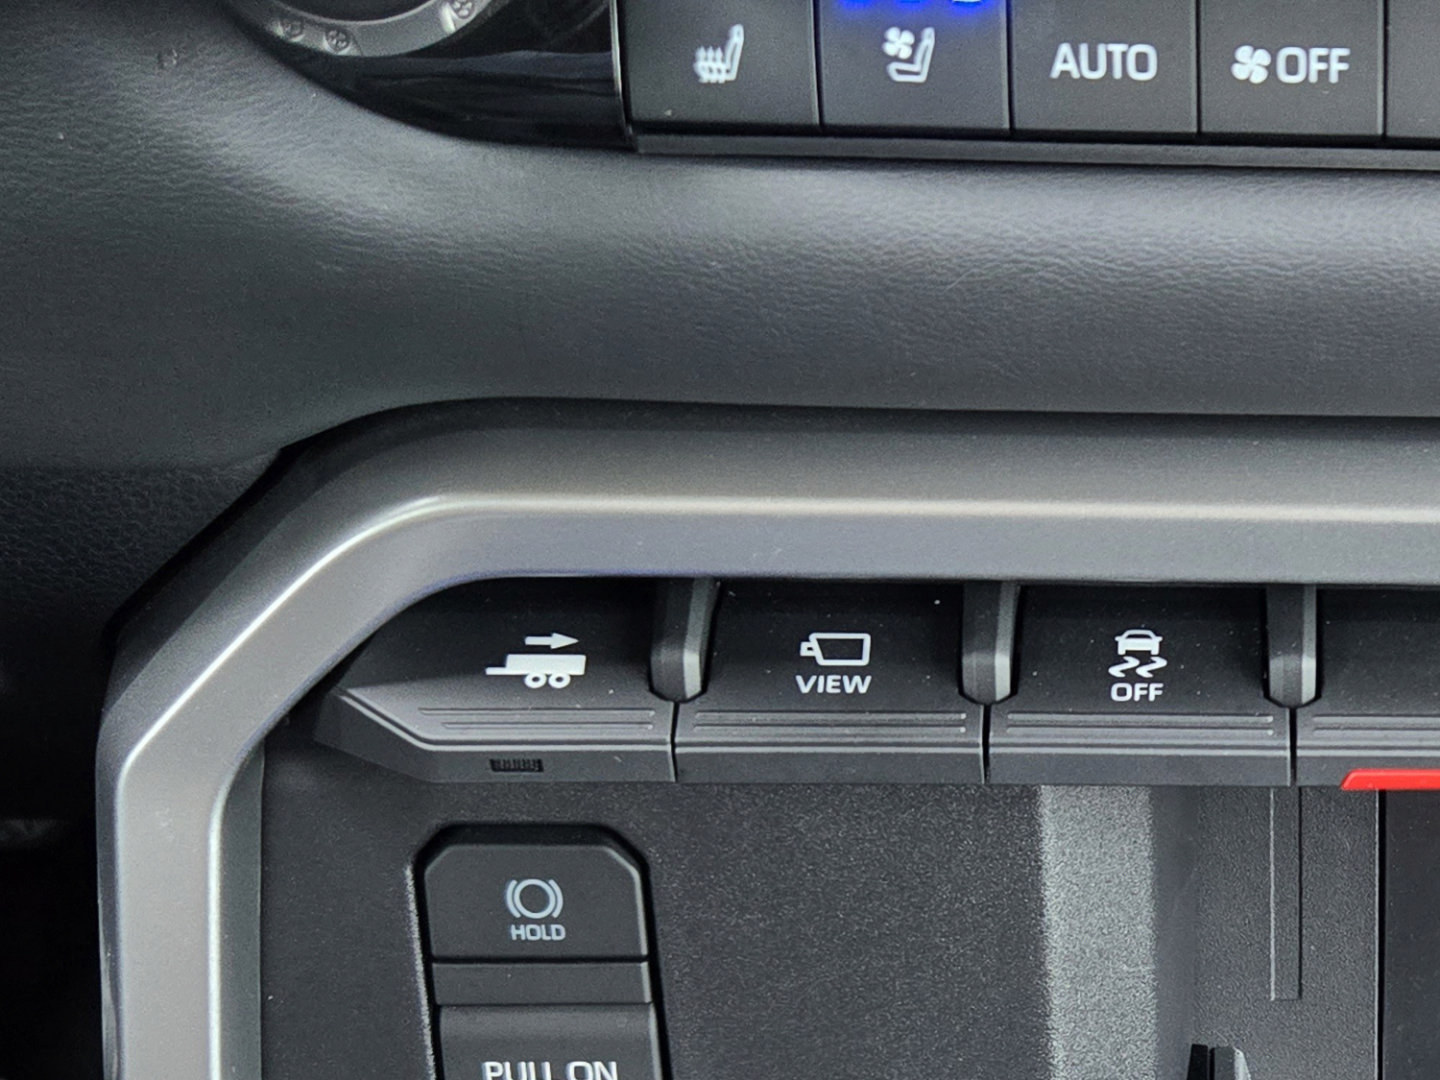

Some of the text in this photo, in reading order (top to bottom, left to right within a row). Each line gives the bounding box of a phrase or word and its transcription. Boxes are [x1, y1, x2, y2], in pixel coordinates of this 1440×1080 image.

[1050, 42, 1159, 81] AUTO
[1275, 46, 1351, 84] OFF
[795, 674, 872, 694] VIEW
[1110, 682, 1164, 702] OFF
[510, 924, 566, 941] HOLD
